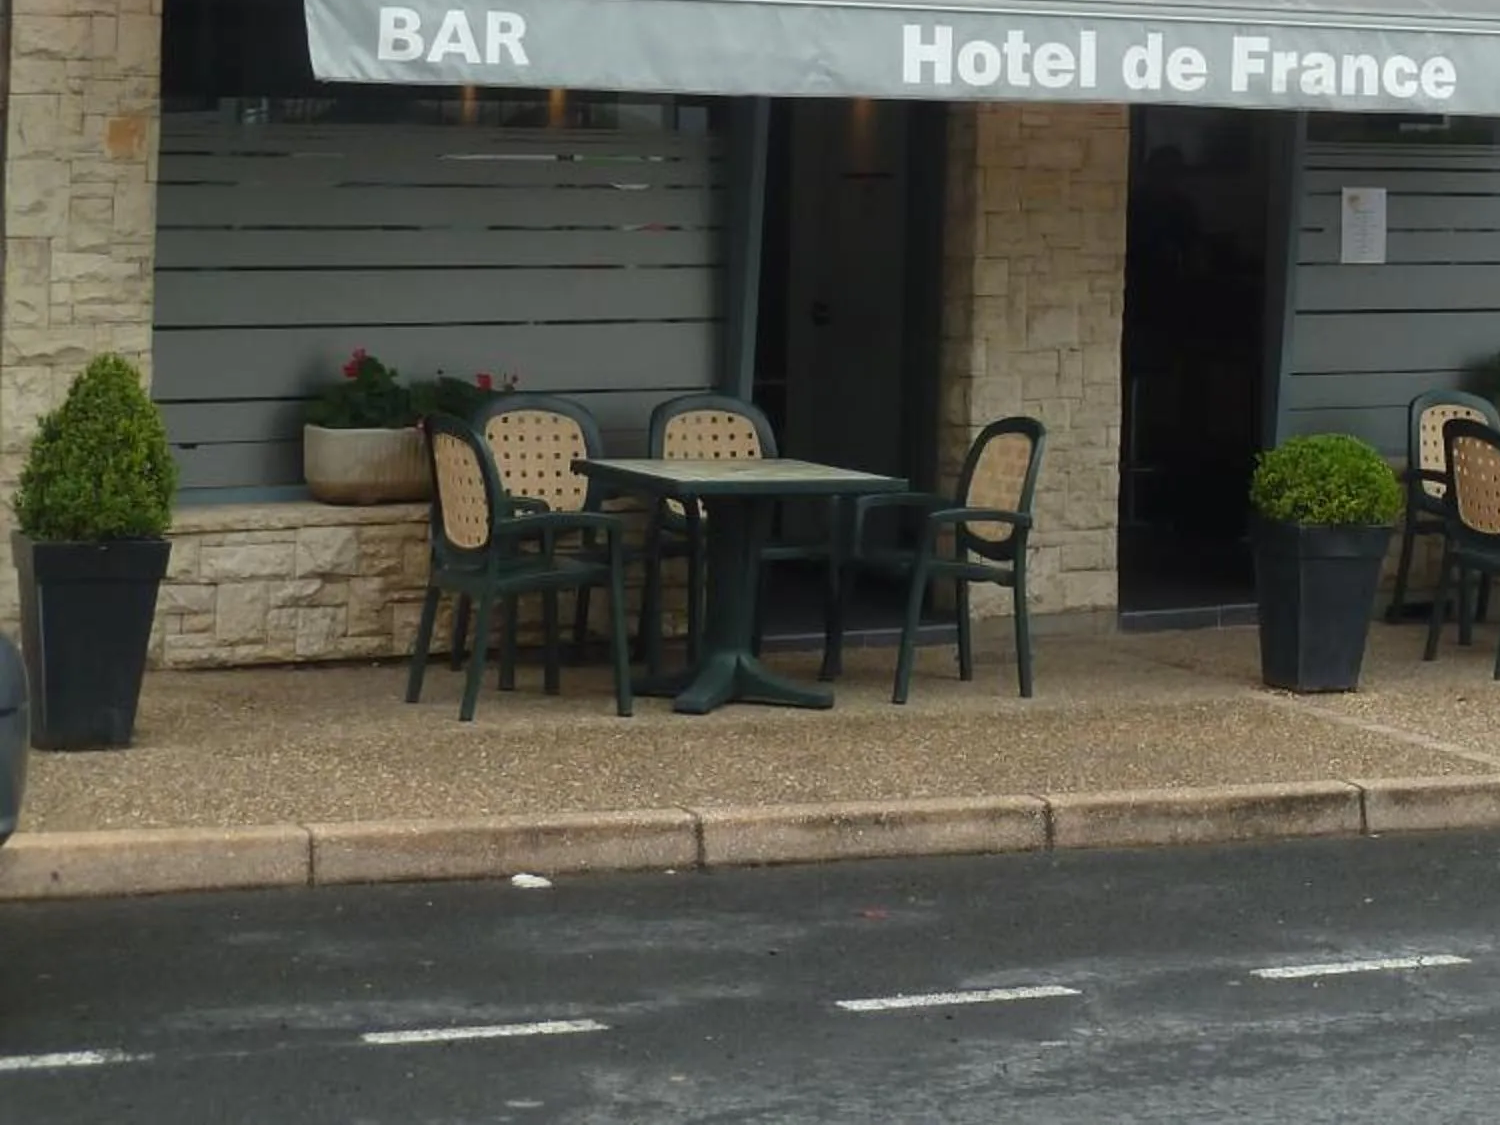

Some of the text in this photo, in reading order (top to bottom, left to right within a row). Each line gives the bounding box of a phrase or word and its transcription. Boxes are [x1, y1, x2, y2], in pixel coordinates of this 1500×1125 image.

[377, 6, 530, 66] BAR
[902, 24, 1457, 100] Hotel de France
